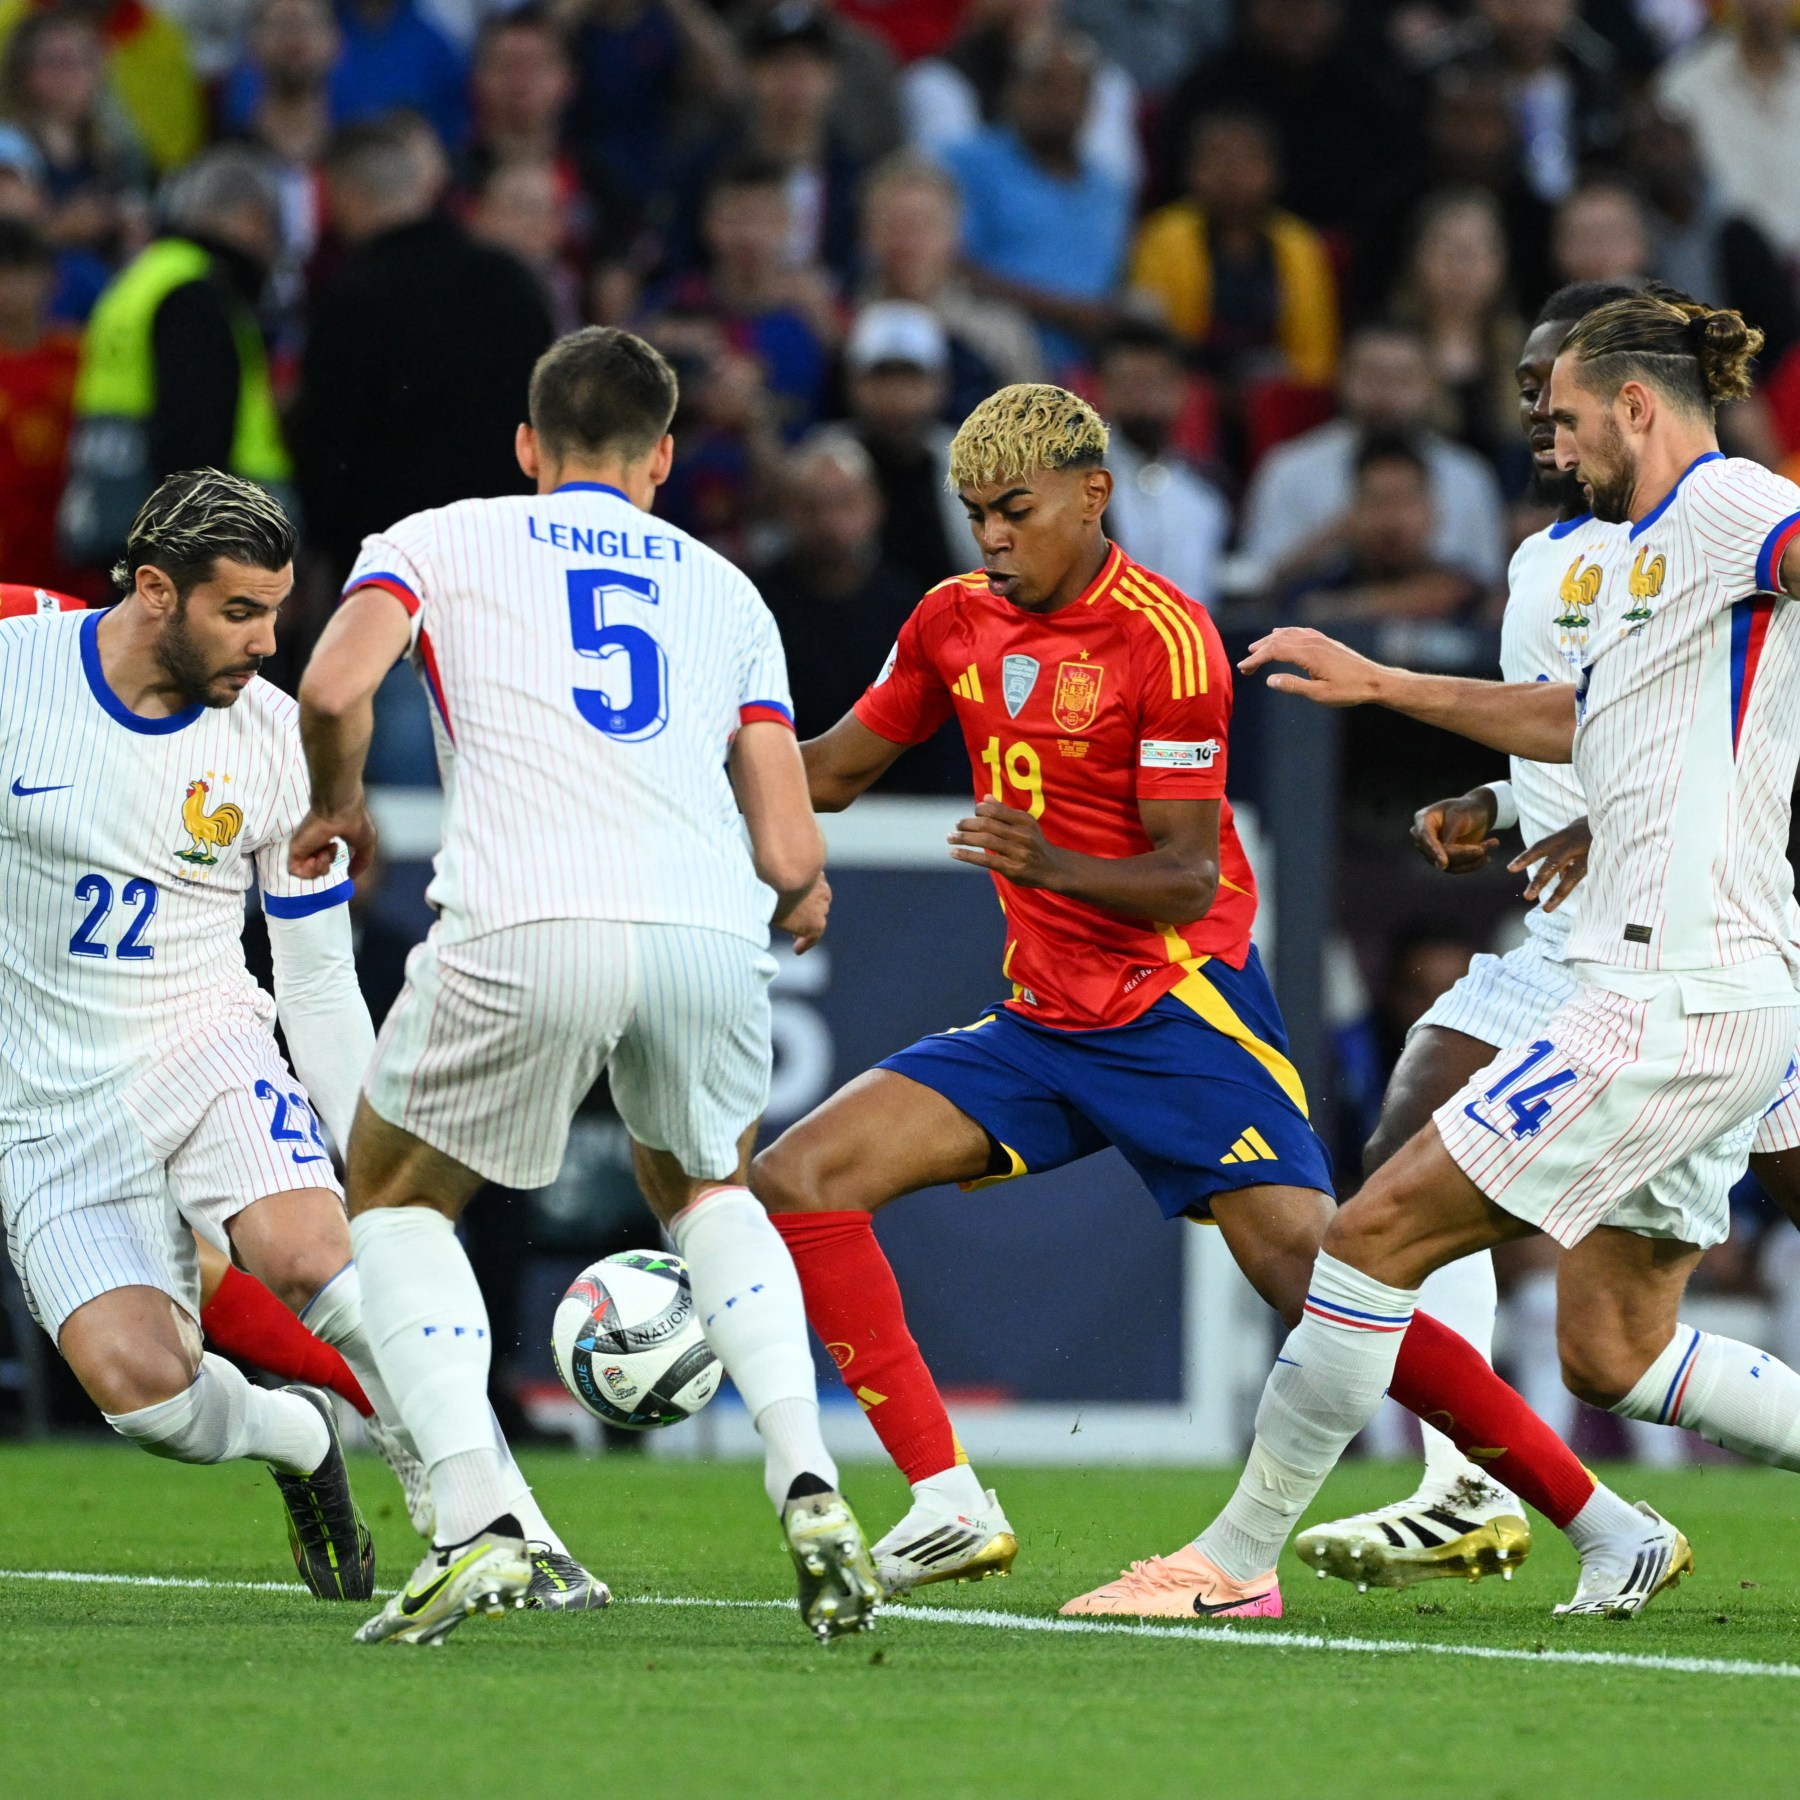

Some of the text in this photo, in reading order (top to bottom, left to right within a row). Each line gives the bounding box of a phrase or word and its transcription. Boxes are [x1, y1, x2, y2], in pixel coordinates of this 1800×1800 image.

[528, 515, 686, 563] LENGLET
[565, 567, 670, 744] 5
[981, 736, 1046, 821] 19
[1142, 747, 1211, 761] FOUNDATION 10
[69, 873, 159, 960] 22
[1484, 1039, 1577, 1141] 14
[635, 1293, 693, 1345] NATIONS
[575, 1363, 616, 1416] LEAGUE
